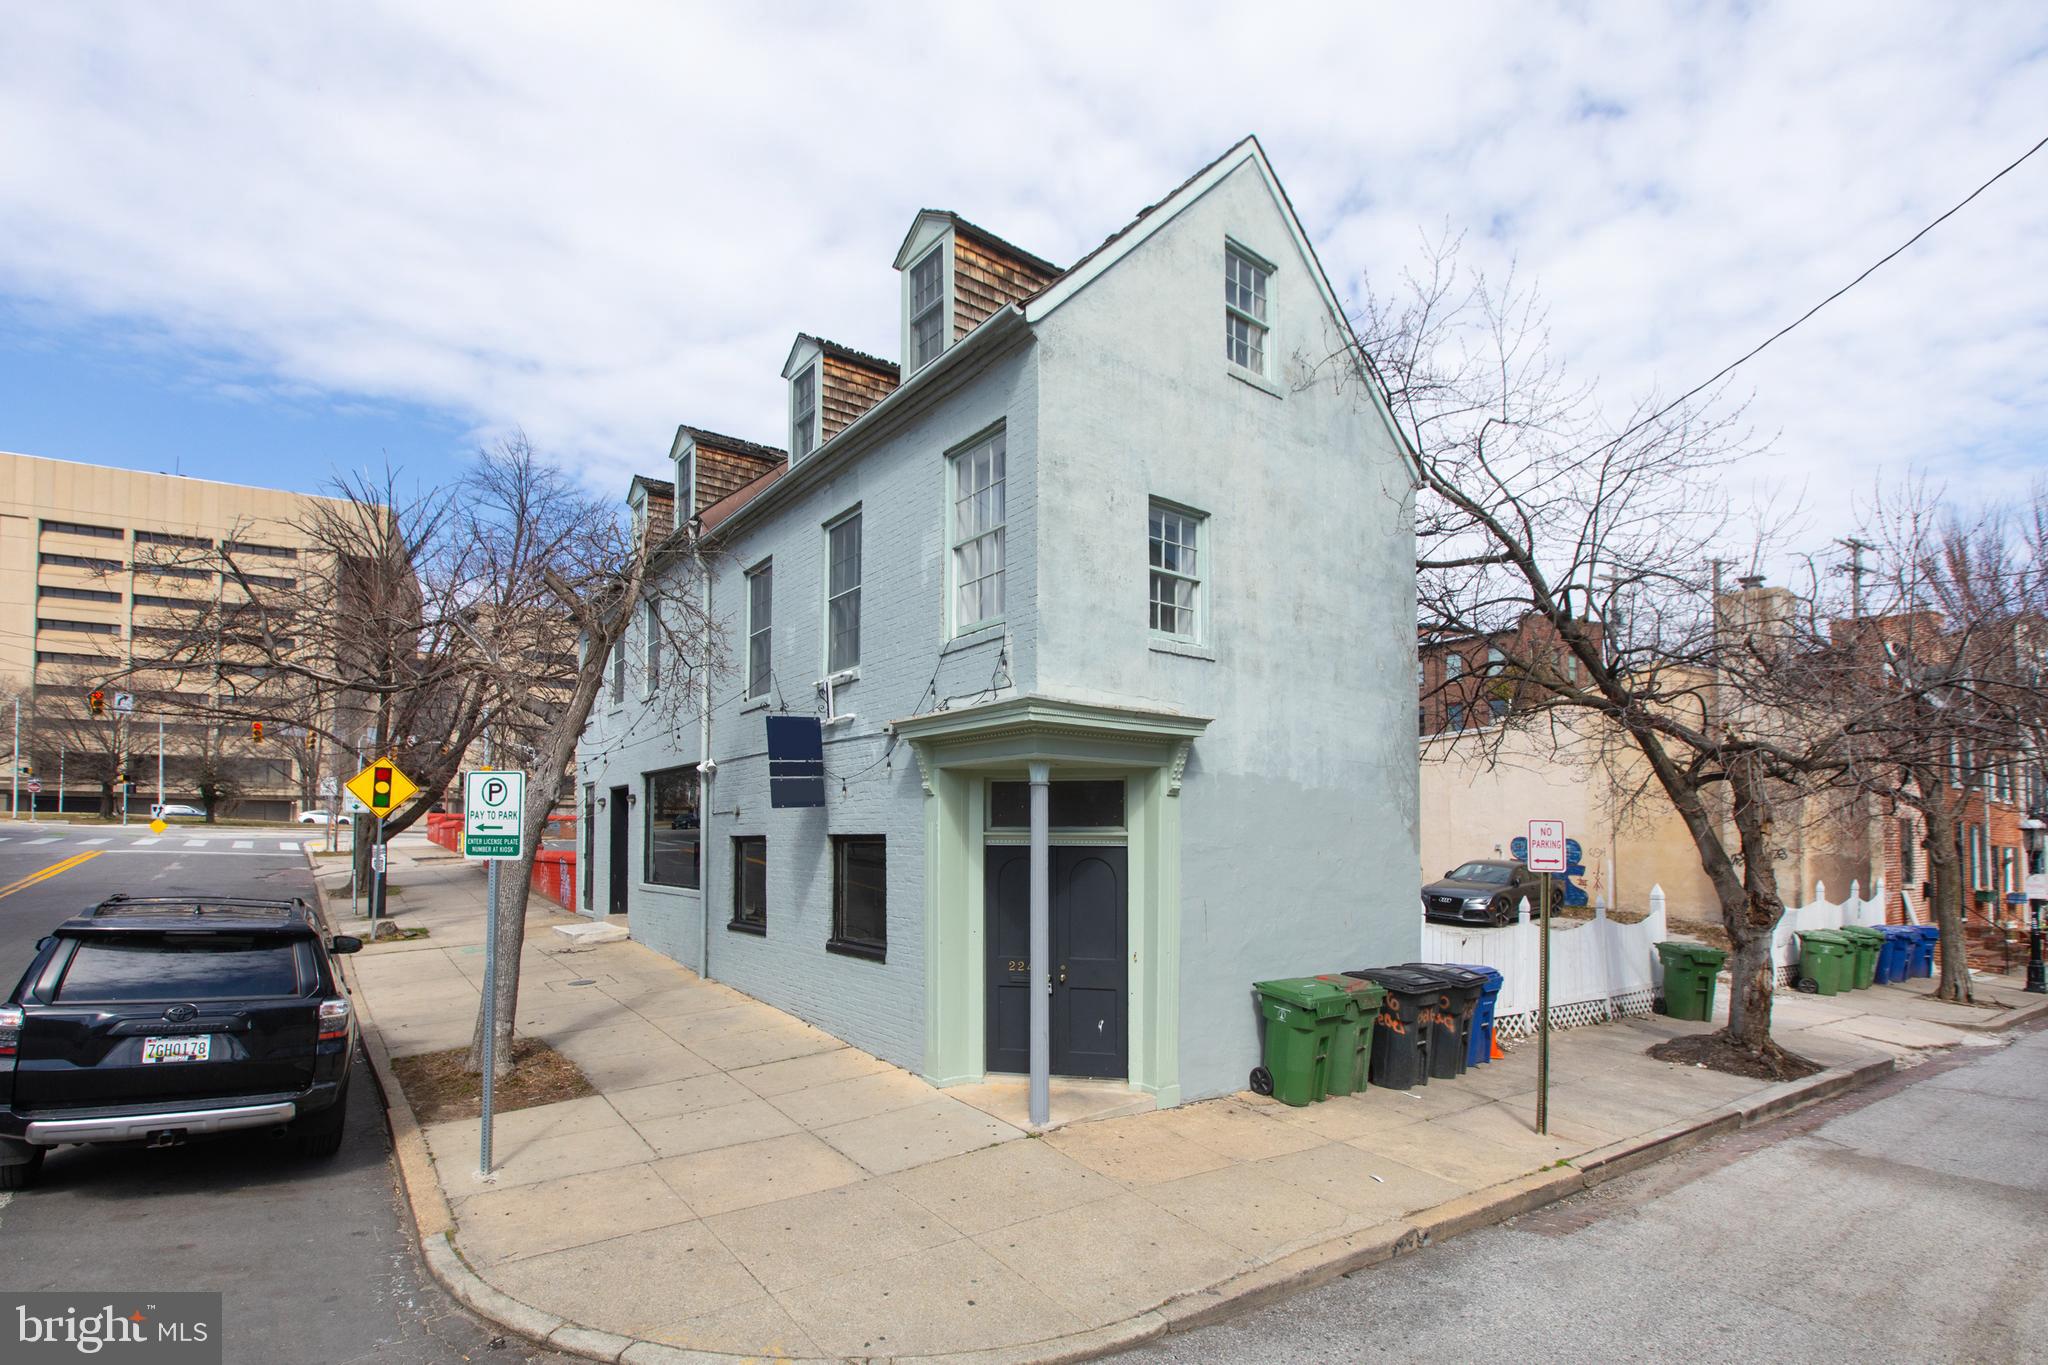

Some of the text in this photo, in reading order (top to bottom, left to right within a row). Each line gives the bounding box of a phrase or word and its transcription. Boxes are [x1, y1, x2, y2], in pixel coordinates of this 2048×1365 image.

[489, 783, 503, 802] P
[470, 810, 518, 820] PAY TO PARK
[1540, 827, 1552, 836] NO
[1532, 840, 1561, 849] PARKING
[1009, 960, 1031, 971] 22
